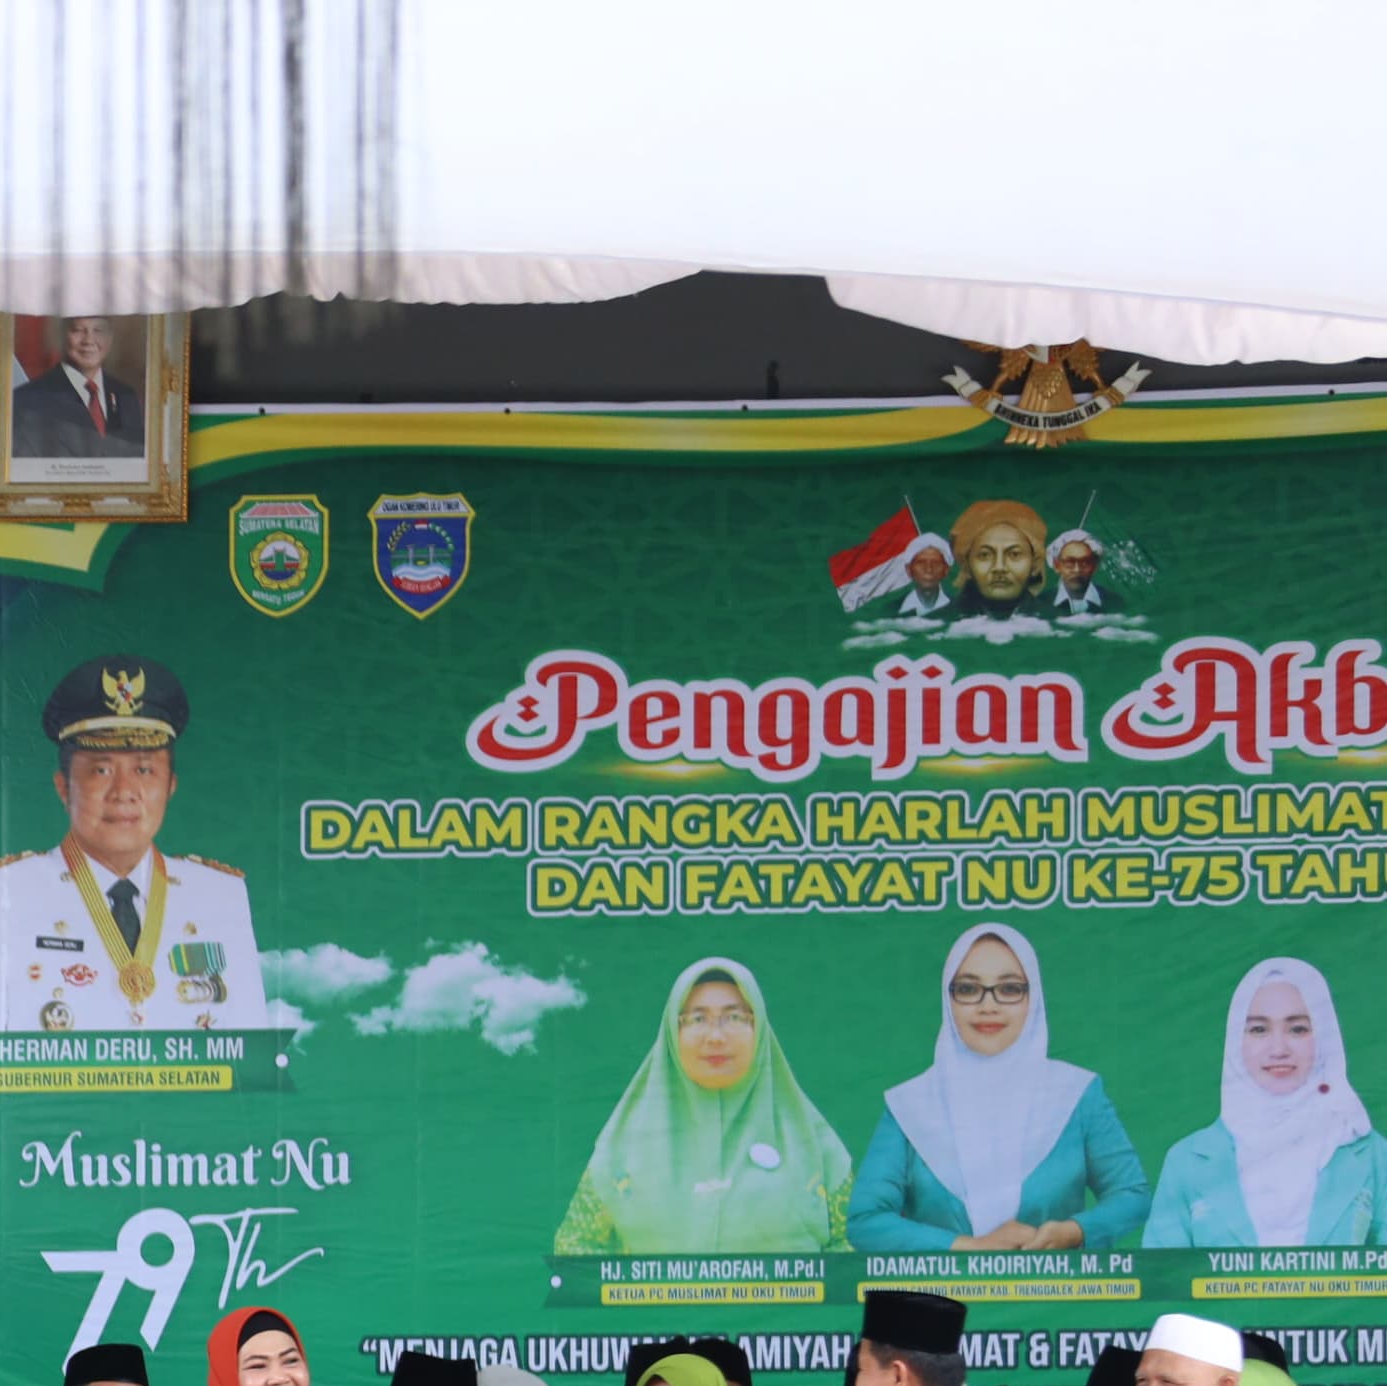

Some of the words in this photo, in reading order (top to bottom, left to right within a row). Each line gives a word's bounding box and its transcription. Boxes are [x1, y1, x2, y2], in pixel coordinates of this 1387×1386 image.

[476, 660, 1084, 771] Pengajian
[309, 807, 525, 851] DALAM
[543, 801, 800, 847] RANGKA
[815, 796, 1066, 844] HARLAH
[536, 864, 665, 907] DAN
[684, 861, 948, 905] FATAYAT
[967, 858, 1057, 900] NU
[1073, 856, 1240, 899] KE-75
[1257, 853, 1387, 896] TAH
[0, 1039, 88, 1062] HERMAN
[95, 1038, 158, 1065] DERU,
[165, 1037, 199, 1061] SH.
[207, 1036, 244, 1060] MM
[77, 1070, 153, 1087] SUMATERA
[159, 1069, 220, 1086] SELATAN
[19, 1130, 263, 1187] Muslimat
[270, 1137, 352, 1191] Nu
[601, 1262, 625, 1280] HJ.
[631, 1261, 661, 1280] SITI
[774, 1259, 825, 1279] M.Pd.I
[866, 1256, 961, 1276] IDAMATUL
[967, 1255, 1075, 1276] KHOIRIYAH,
[1080, 1254, 1103, 1274] M.
[1109, 1253, 1133, 1273] Pd
[1208, 1252, 1254, 1272] YUNI
[1260, 1251, 1335, 1271] KARTINI
[39, 1207, 195, 1377] 79
[609, 1288, 645, 1300] KETUA
[649, 1288, 664, 1299] PC
[668, 1287, 728, 1299] MUSLIMAT
[732, 1287, 748, 1298] NU
[751, 1286, 775, 1298] OKU
[779, 1286, 815, 1298] TIMUR
[950, 1285, 987, 1297] FATAYAT
[1014, 1284, 1073, 1296] TRENGGALEK
[1076, 1284, 1102, 1295] JAWA
[1106, 1283, 1135, 1295] TIMUR
[1206, 1282, 1240, 1294] KETUA
[1244, 1282, 1258, 1293] PC
[1262, 1281, 1306, 1293] FATAYAT
[1310, 1281, 1324, 1292] NU
[1328, 1280, 1350, 1292] OKU
[1029, 1332, 1050, 1367] &
